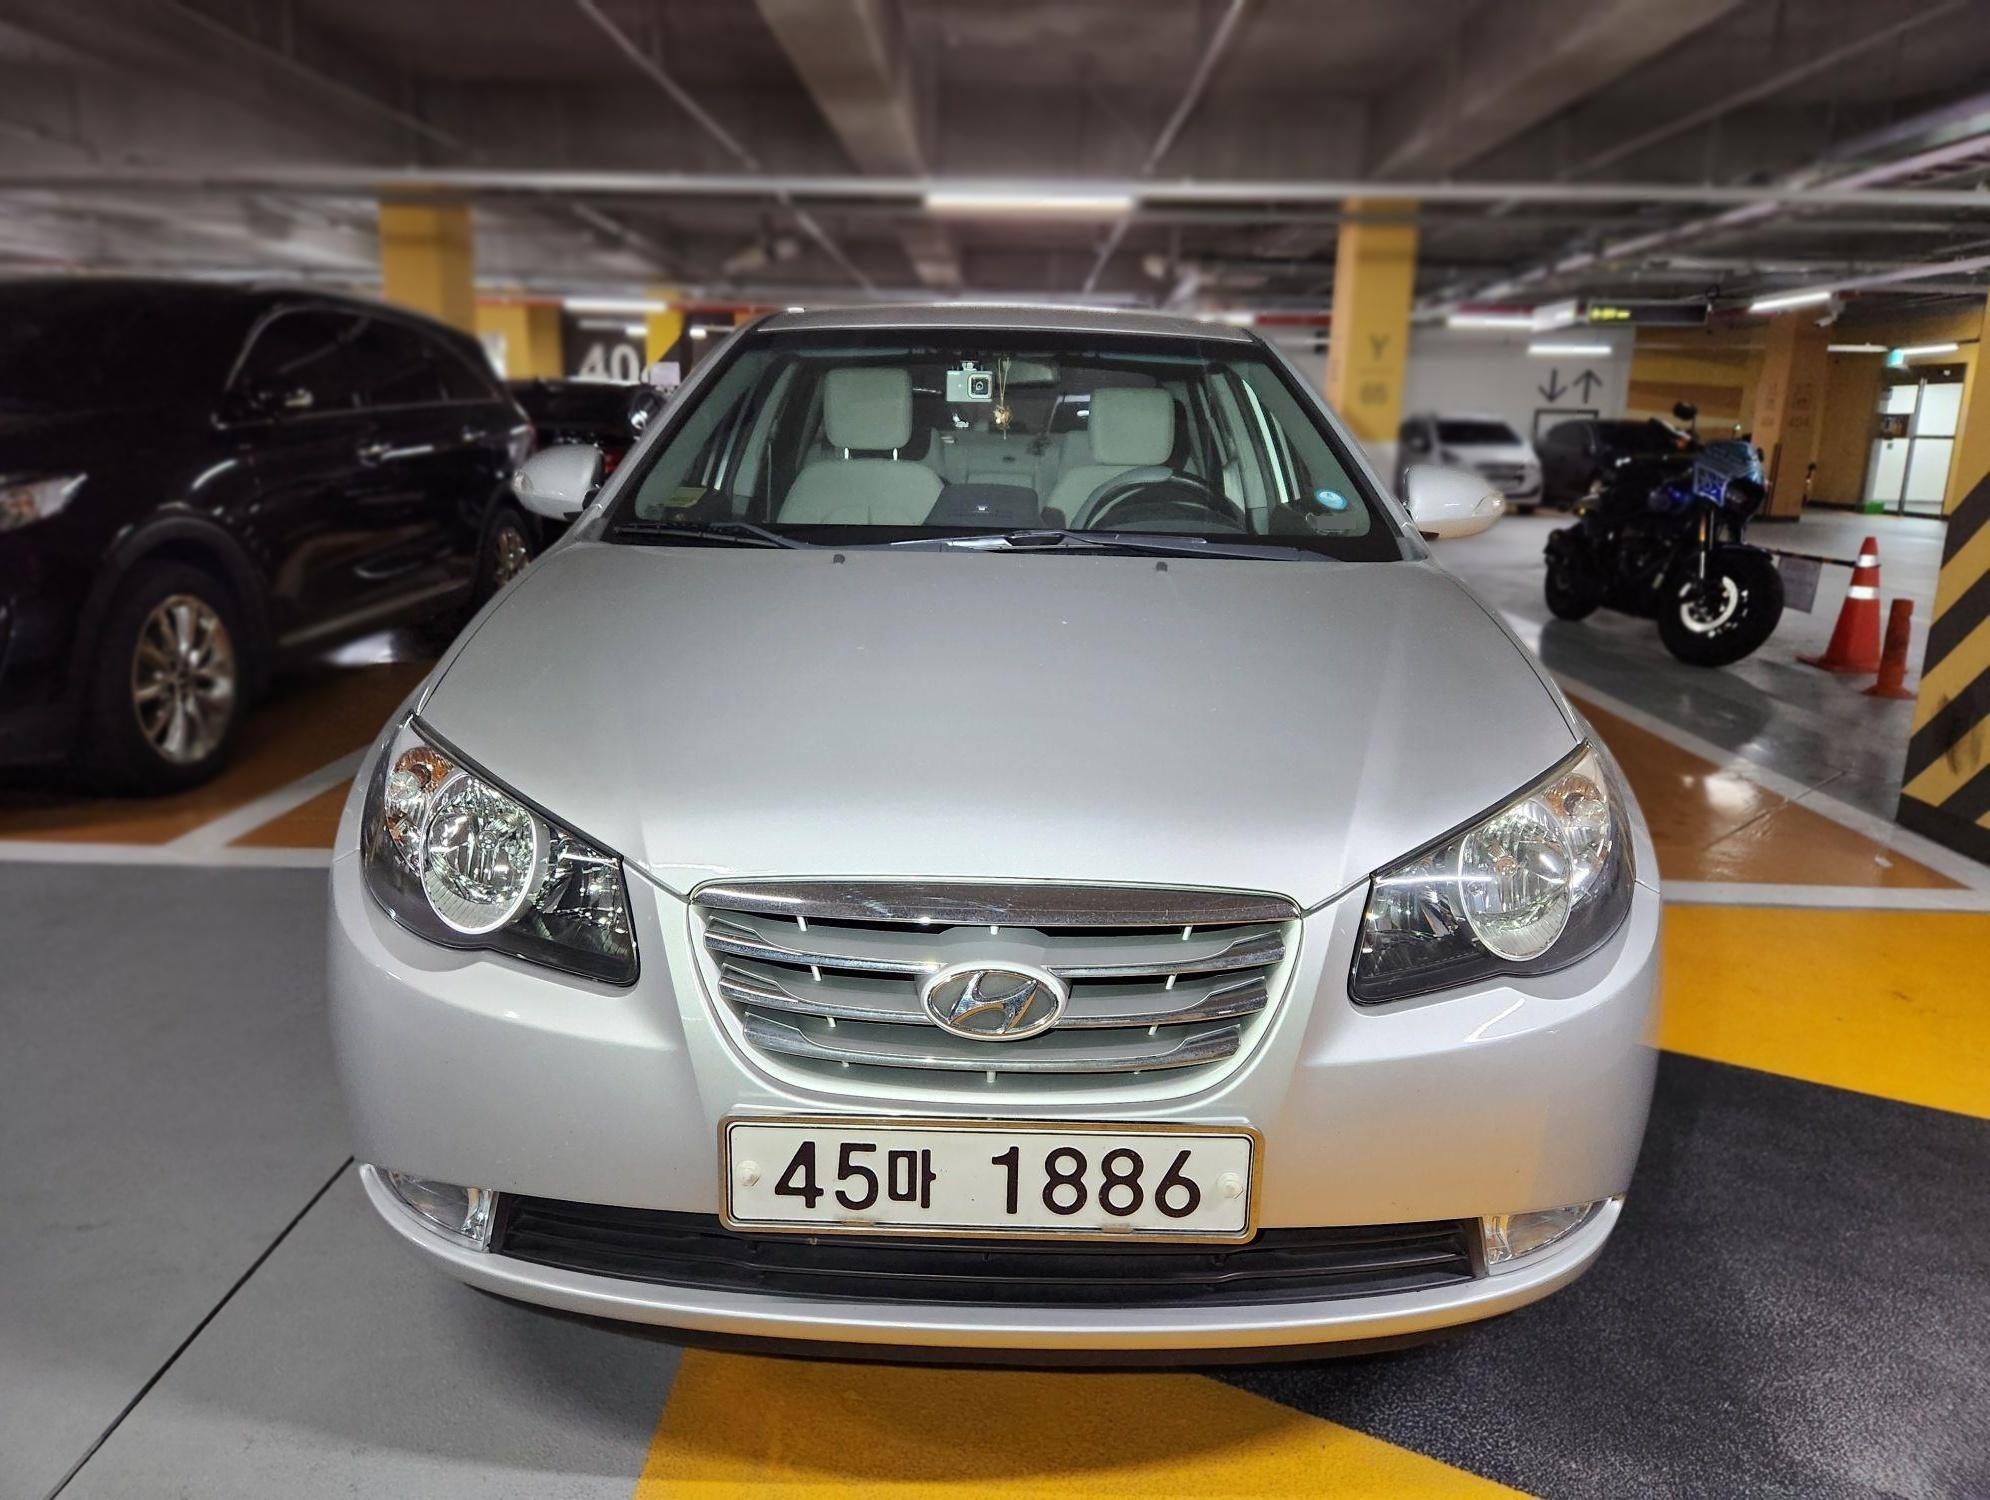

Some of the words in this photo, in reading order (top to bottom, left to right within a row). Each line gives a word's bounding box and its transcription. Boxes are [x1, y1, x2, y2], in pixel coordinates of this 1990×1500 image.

[579, 343, 650, 385] 40
[774, 1140, 936, 1211] 45마
[991, 1145, 1202, 1218] 1886
